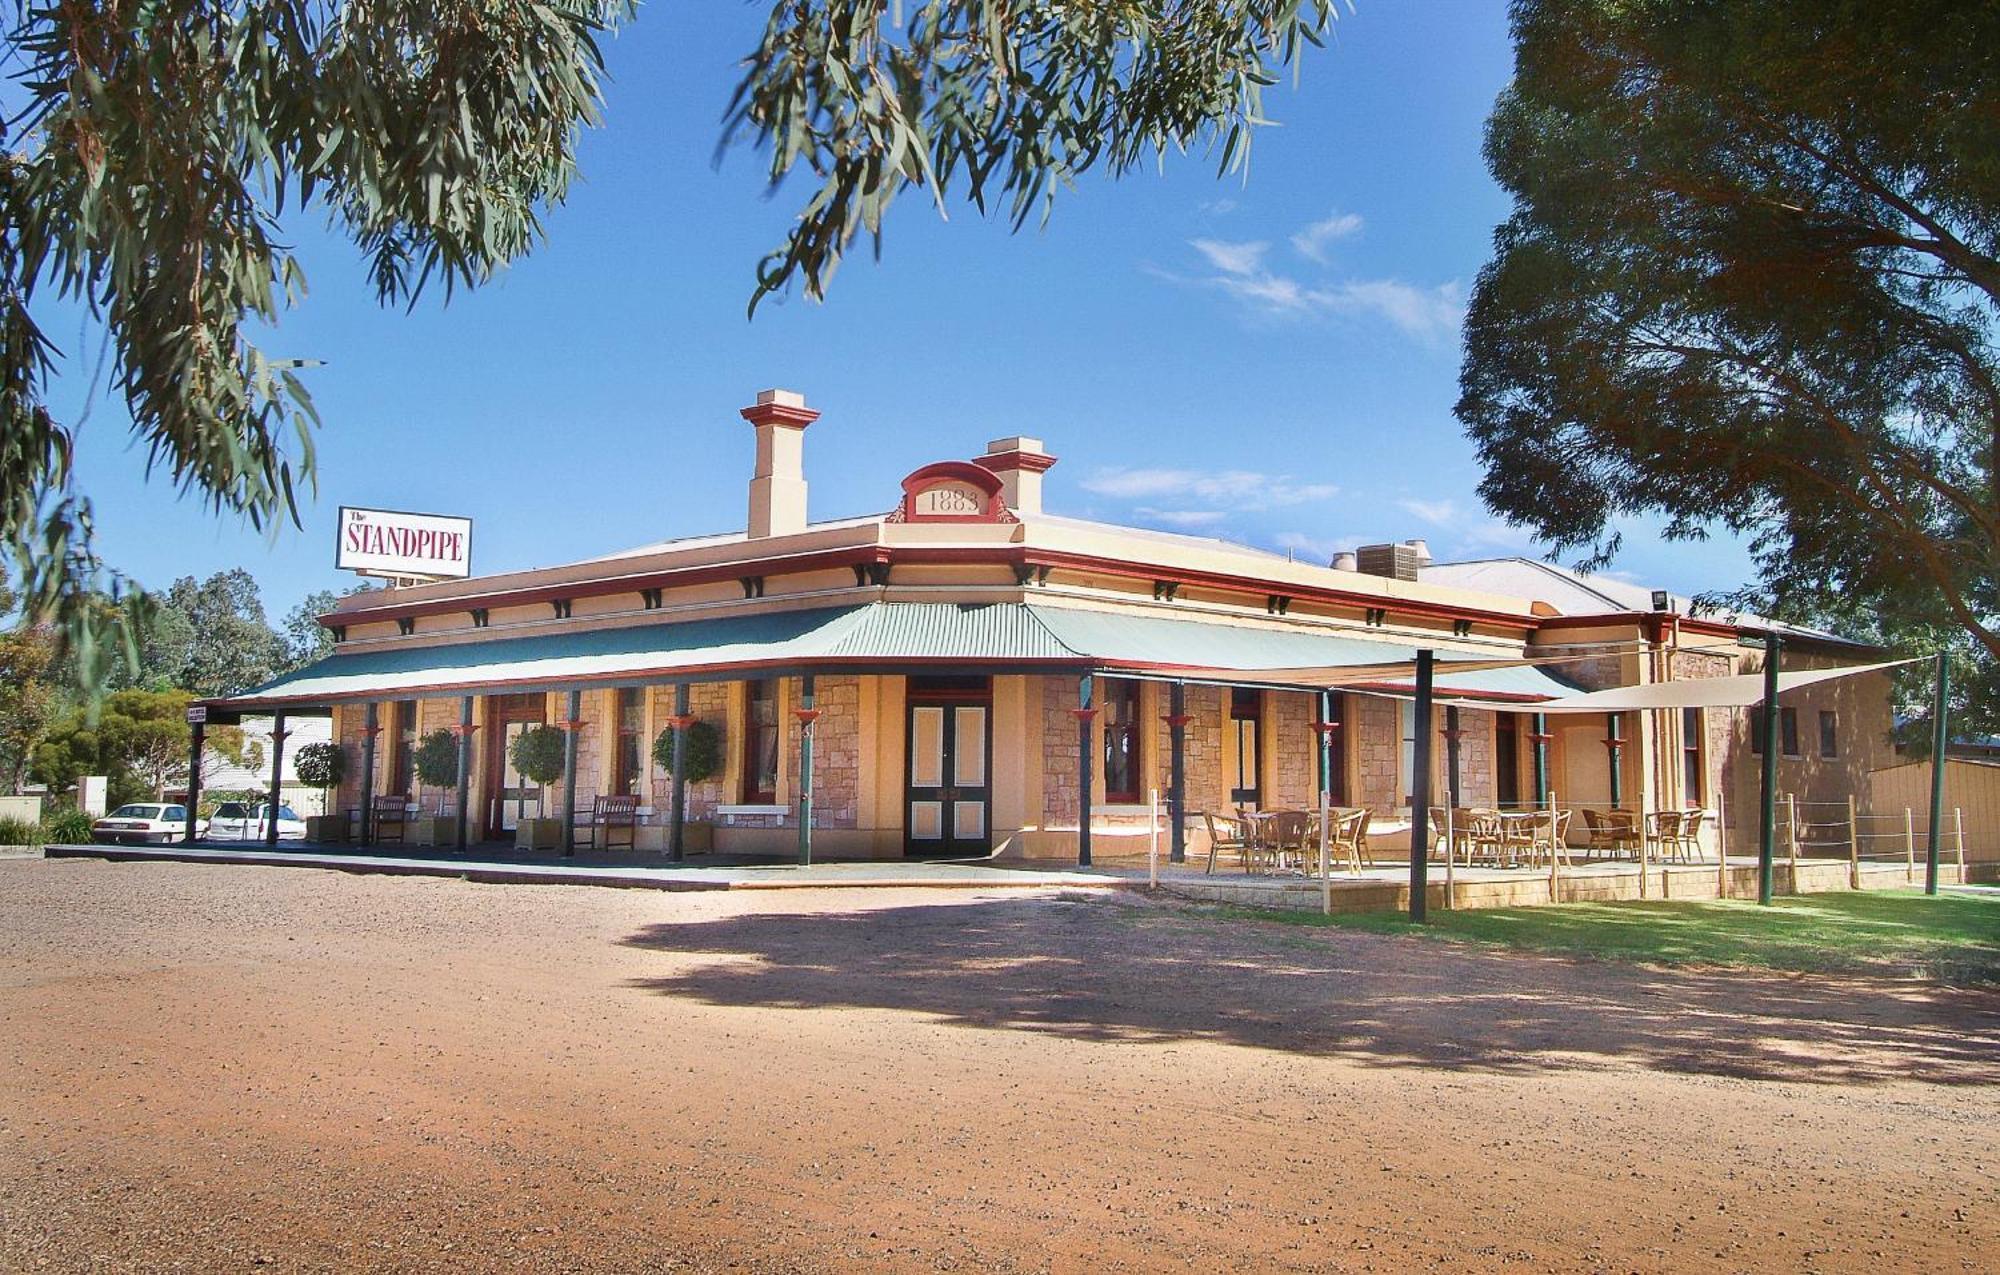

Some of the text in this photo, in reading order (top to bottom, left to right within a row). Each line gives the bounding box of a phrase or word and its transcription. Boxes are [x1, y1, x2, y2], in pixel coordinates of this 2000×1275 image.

[931, 489, 978, 511] 1883
[350, 510, 367, 521] The
[346, 522, 463, 562] STANDPIPE
